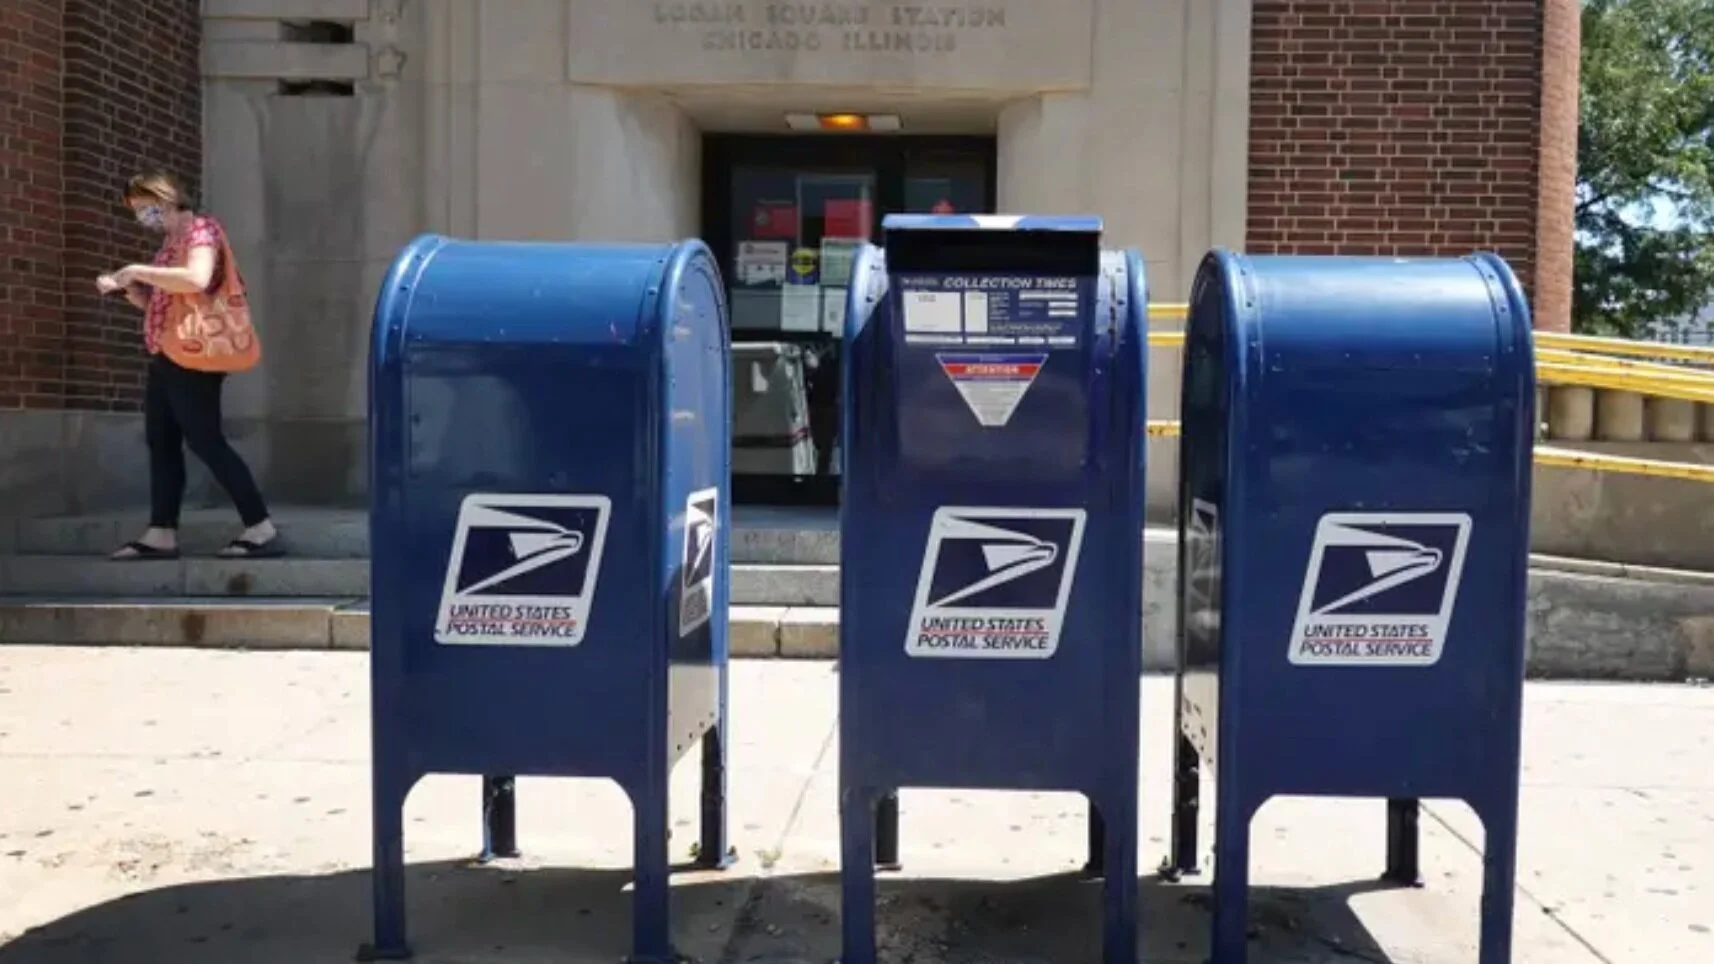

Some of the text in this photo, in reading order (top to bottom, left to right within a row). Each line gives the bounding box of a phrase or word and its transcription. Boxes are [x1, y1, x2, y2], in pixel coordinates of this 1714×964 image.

[890, 5, 1006, 27] STATION
[701, 31, 956, 52] CHICAGO ILLINOIS
[943, 277, 1032, 288] COLLECTION
[1035, 278, 1076, 288] TIMES
[450, 604, 571, 619] UNITED STATES
[446, 620, 576, 637] POSTAL SERVICE
[920, 616, 1045, 631] UNITED STATES
[1304, 623, 1428, 637] UNITED STATES
[917, 634, 1048, 649] POSTAL SERVICE
[1300, 640, 1433, 656] POSTAL SERVICE
